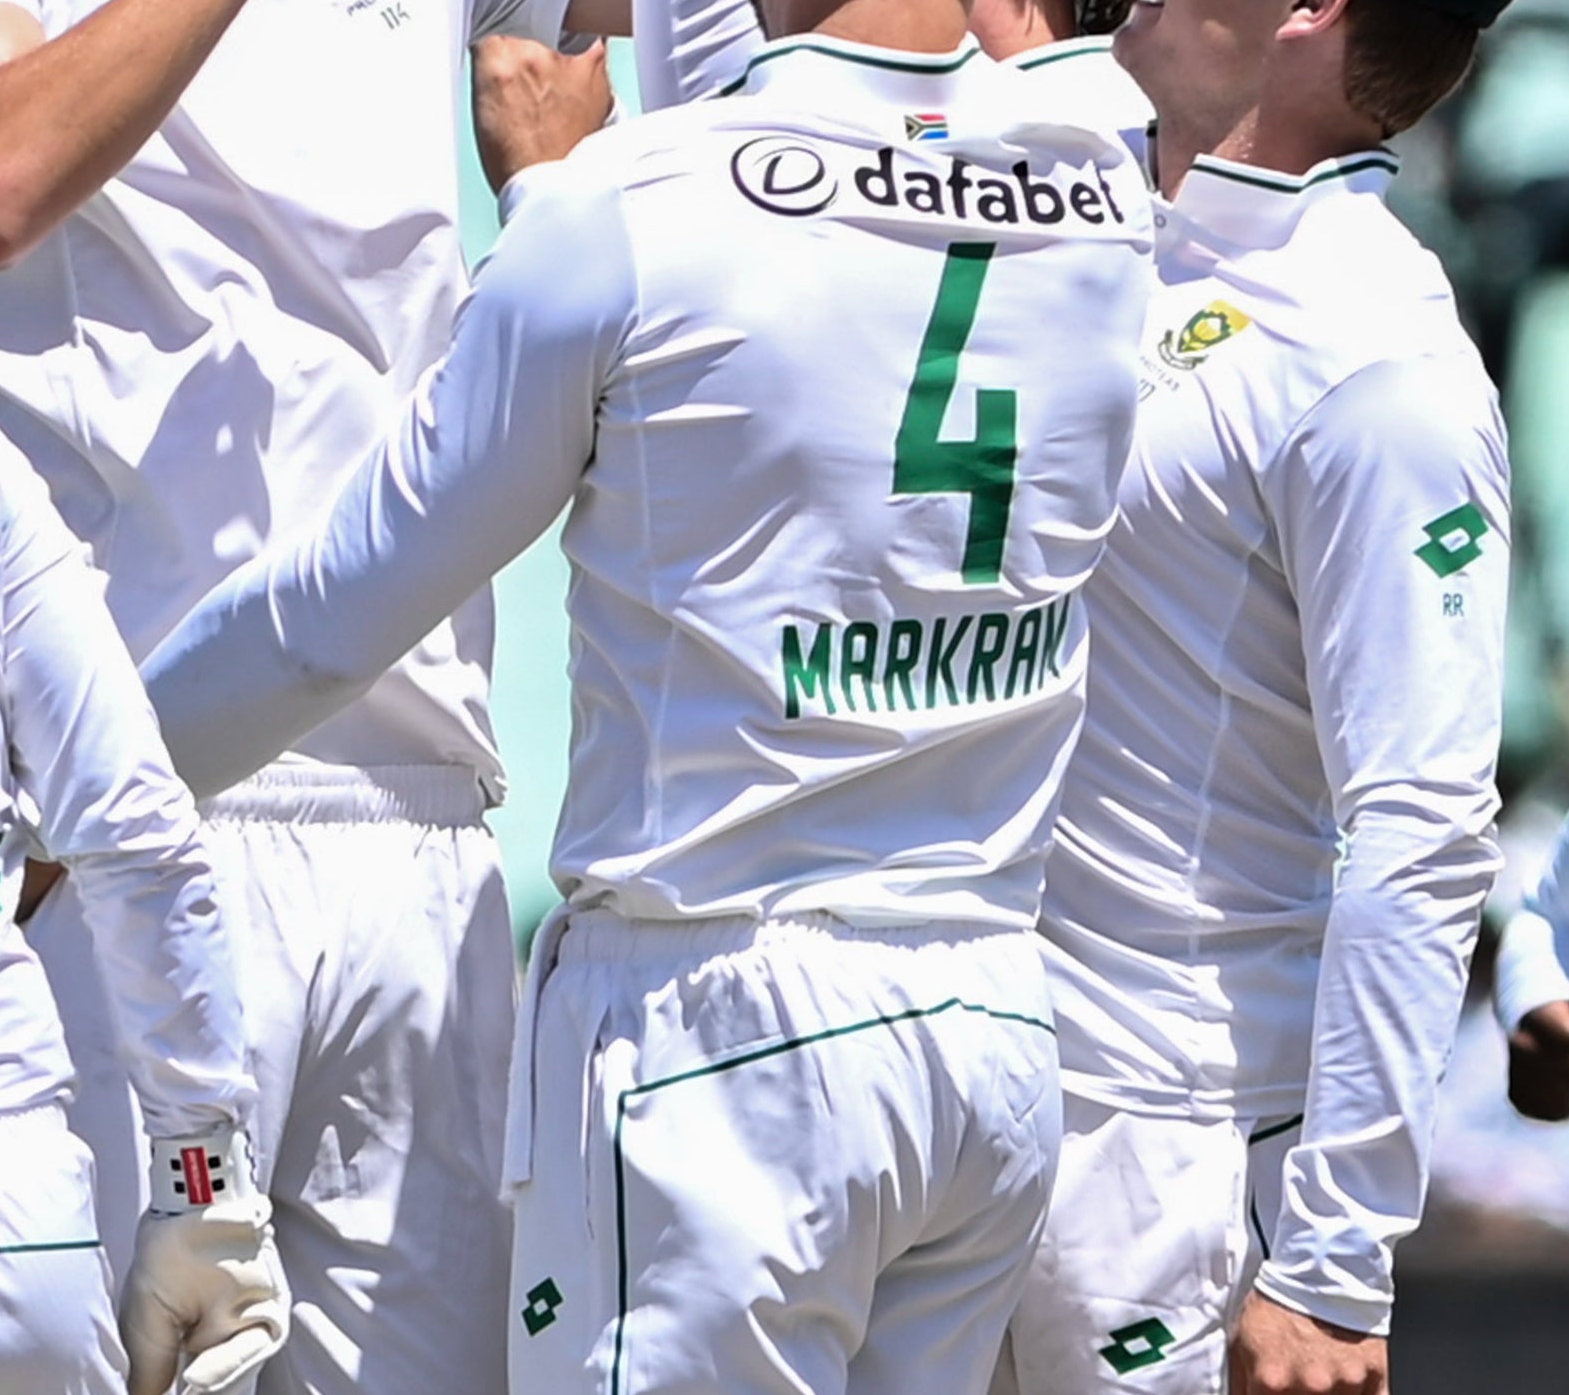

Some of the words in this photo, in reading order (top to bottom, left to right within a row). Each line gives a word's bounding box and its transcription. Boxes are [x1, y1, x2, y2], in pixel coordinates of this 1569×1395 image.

[854, 146, 1125, 225] dafabet
[892, 241, 1017, 584] 4
[1443, 593, 1464, 617] RR
